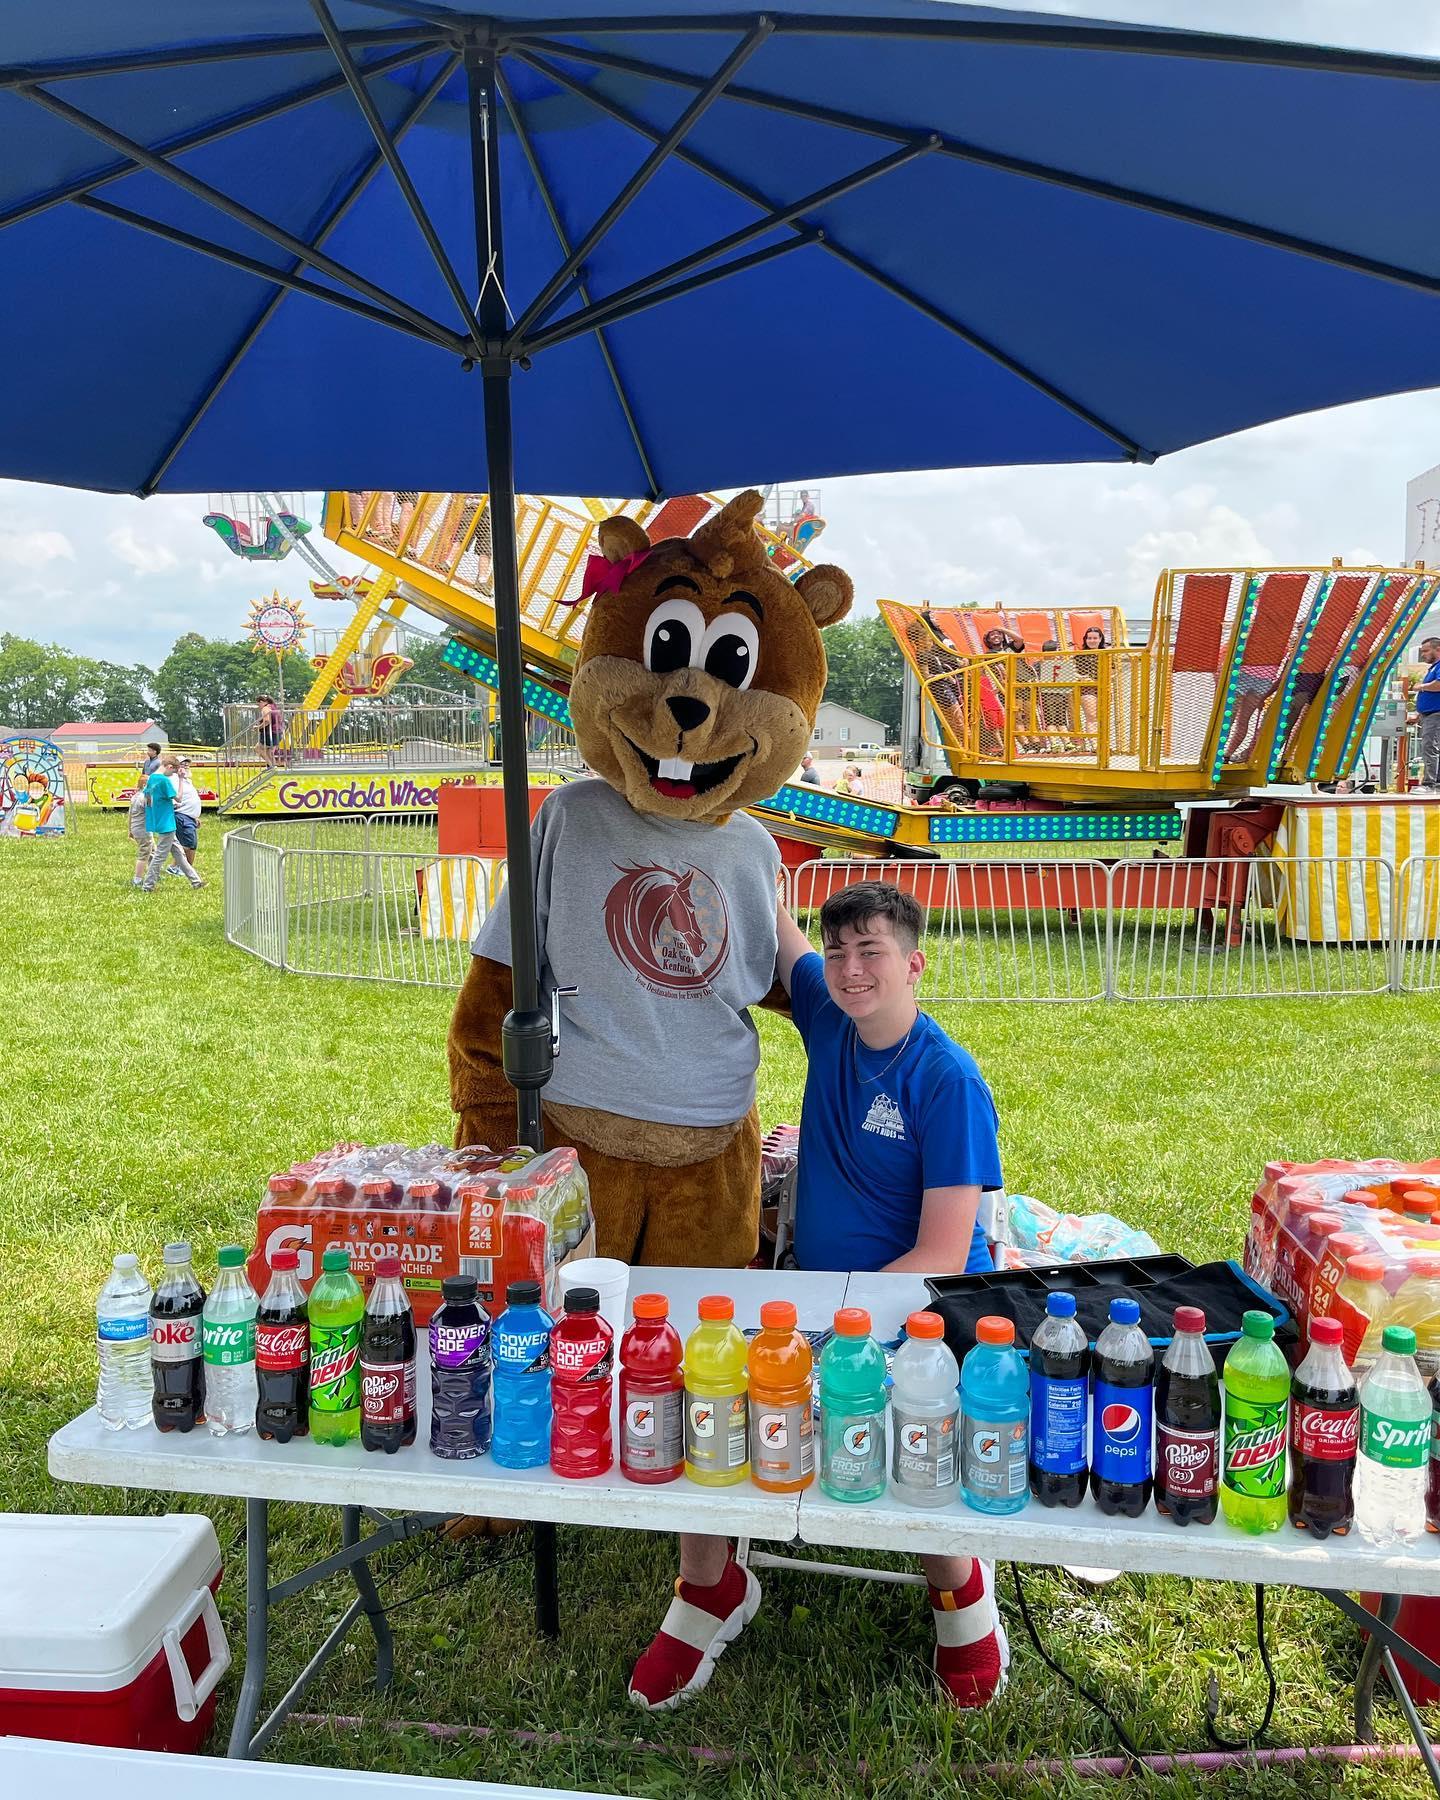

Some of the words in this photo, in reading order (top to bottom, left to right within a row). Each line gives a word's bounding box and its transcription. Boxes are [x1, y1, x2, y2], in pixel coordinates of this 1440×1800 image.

[279, 781, 386, 809] Gondola
[389, 780, 438, 807] Whe
[662, 947, 677, 958] Oak
[679, 950, 694, 963] Gro
[663, 959, 696, 977] Kentucky
[880, 1127, 897, 1139] RIDES
[470, 1201, 494, 1218] 20
[469, 1225, 492, 1241] 24
[469, 1241, 492, 1249] PACK
[350, 1261, 375, 1271] IRST
[400, 1263, 433, 1275] NCHER
[1320, 1260, 1340, 1284] 20
[1275, 1262, 1305, 1310] ORADE
[1314, 1285, 1330, 1309] 24
[126, 1323, 144, 1331] Water
[152, 1324, 195, 1345] oke
[438, 1325, 486, 1340] POWER
[203, 1326, 243, 1346] rite
[500, 1332, 548, 1347] POWER
[437, 1339, 465, 1352] ADE
[500, 1345, 527, 1359] ADE
[557, 1340, 606, 1354] POWER
[557, 1353, 584, 1366] ADE
[363, 1376, 396, 1398] Pepper
[372, 1376, 387, 1387] Dr
[368, 1401, 377, 1410] 23
[626, 1401, 655, 1437] G
[690, 1401, 715, 1438] G
[1302, 1405, 1359, 1439] Coca-C
[759, 1413, 788, 1450] G
[843, 1421, 871, 1456] G
[900, 1423, 928, 1455] G
[1372, 1420, 1432, 1449] Sprit
[972, 1430, 1001, 1463] G
[1105, 1444, 1137, 1458] pepsi
[1180, 1444, 1198, 1456] Dr
[1166, 1444, 1207, 1467] Pepper
[831, 1459, 867, 1472] FROST
[899, 1458, 934, 1472] FROST
[969, 1467, 1006, 1484] FROST
[1175, 1471, 1185, 1480] 23
